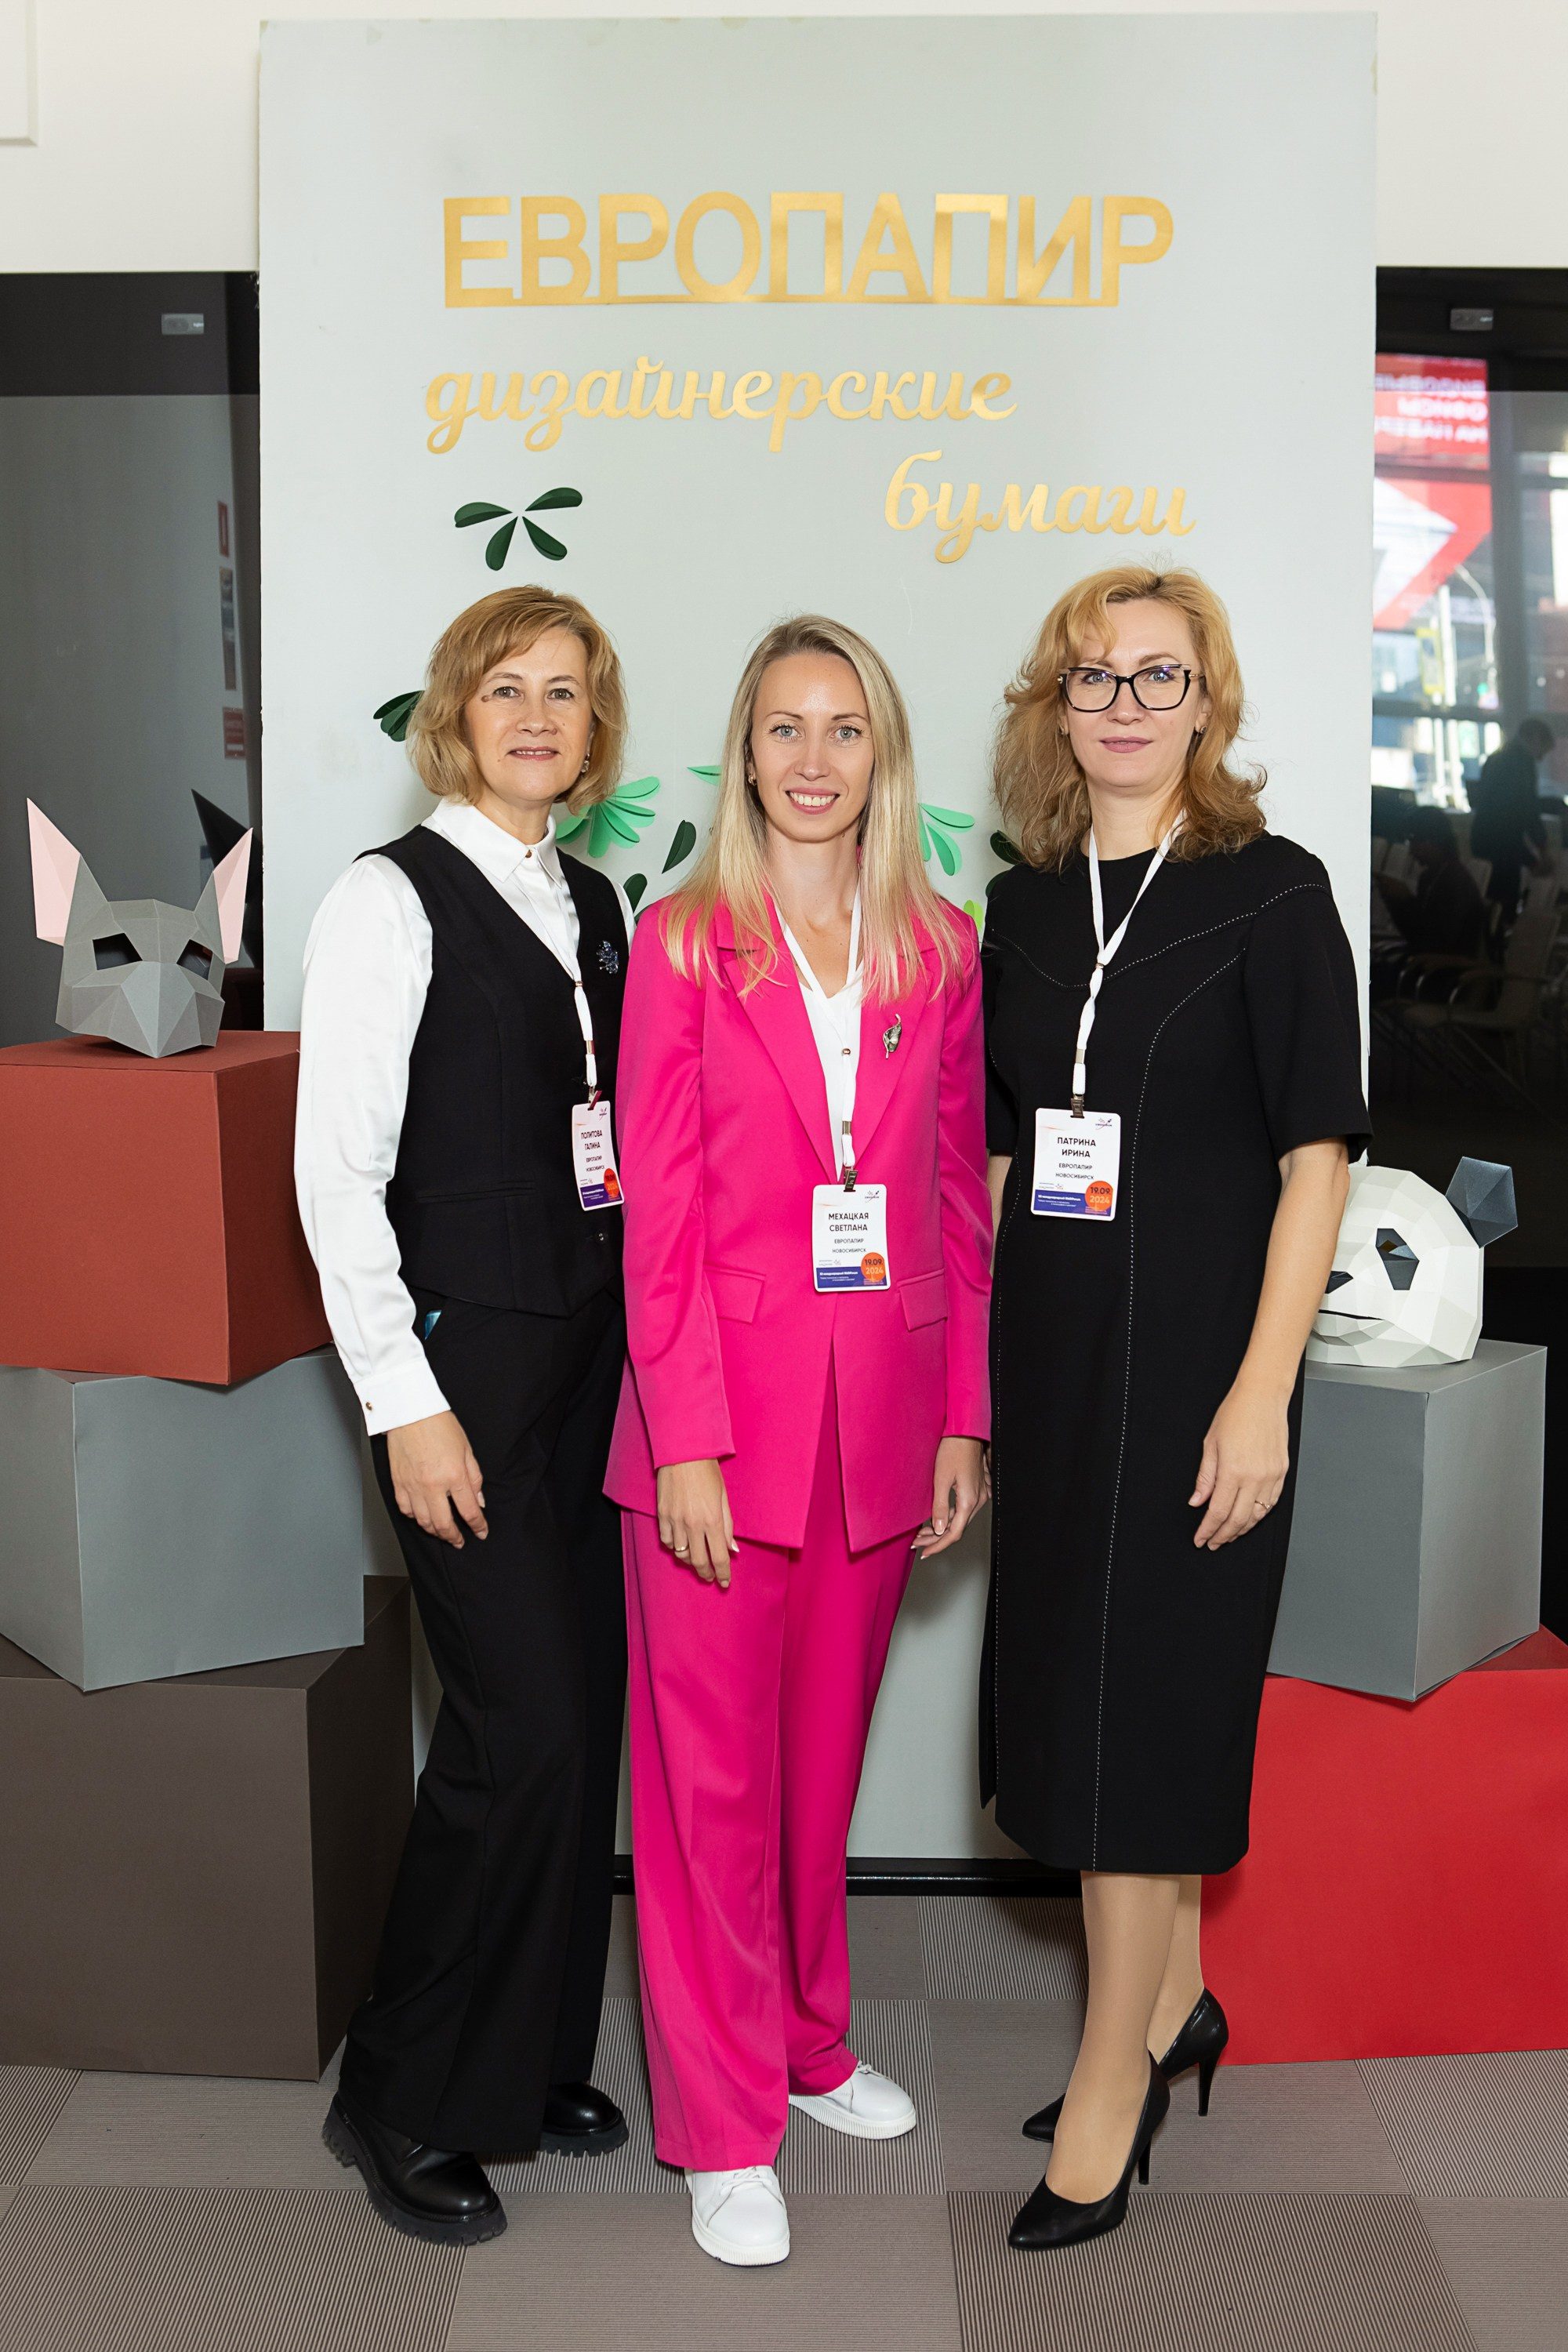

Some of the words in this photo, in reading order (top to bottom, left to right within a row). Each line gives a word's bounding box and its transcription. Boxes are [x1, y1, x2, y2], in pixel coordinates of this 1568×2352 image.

[444, 191, 1174, 307] ЕВРОПАПИР
[425, 355, 1018, 454] дизайнерские
[884, 448, 1196, 564] бумаги
[584, 1142, 601, 1150] ГАЛИНА
[1057, 1137, 1097, 1147] ПАТРИНА
[1062, 1149, 1091, 1158] ИРИНА
[1089, 1196, 1110, 1204] 2024
[828, 1212, 869, 1221] МЕХАЦКАЯ
[829, 1224, 868, 1232] СВЕТЛАНА
